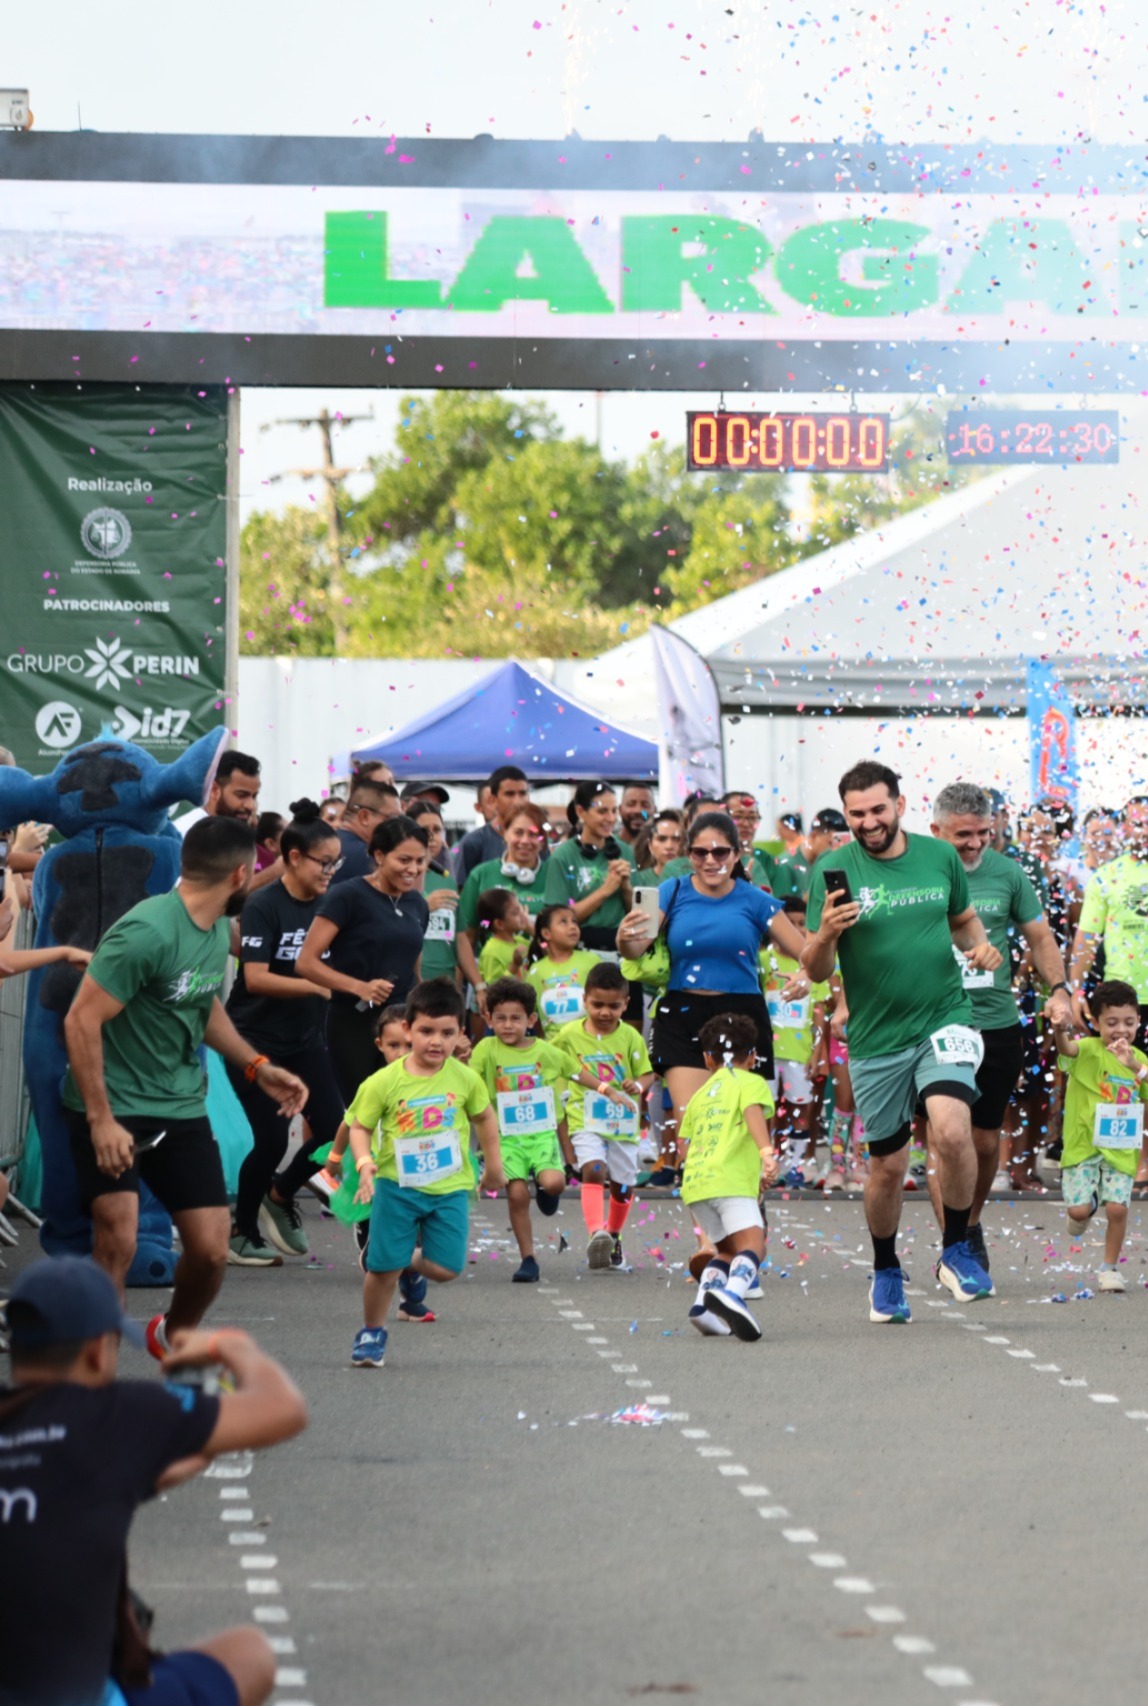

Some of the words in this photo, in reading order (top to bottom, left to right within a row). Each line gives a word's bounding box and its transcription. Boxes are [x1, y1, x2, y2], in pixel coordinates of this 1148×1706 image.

[693, 417, 883, 466] 00:00:00
[957, 422, 1113, 454] 16:22:30
[68, 477, 153, 496] Realização
[43, 599, 170, 613] PATROCINADORES
[7, 654, 85, 674] GRUPO
[133, 655, 200, 675] PERIN
[397, 1106, 457, 1133] KIDS
[515, 1103, 536, 1122] 68
[605, 1101, 625, 1119] 69
[1109, 1118, 1127, 1137] 82
[415, 1153, 438, 1174] 36
